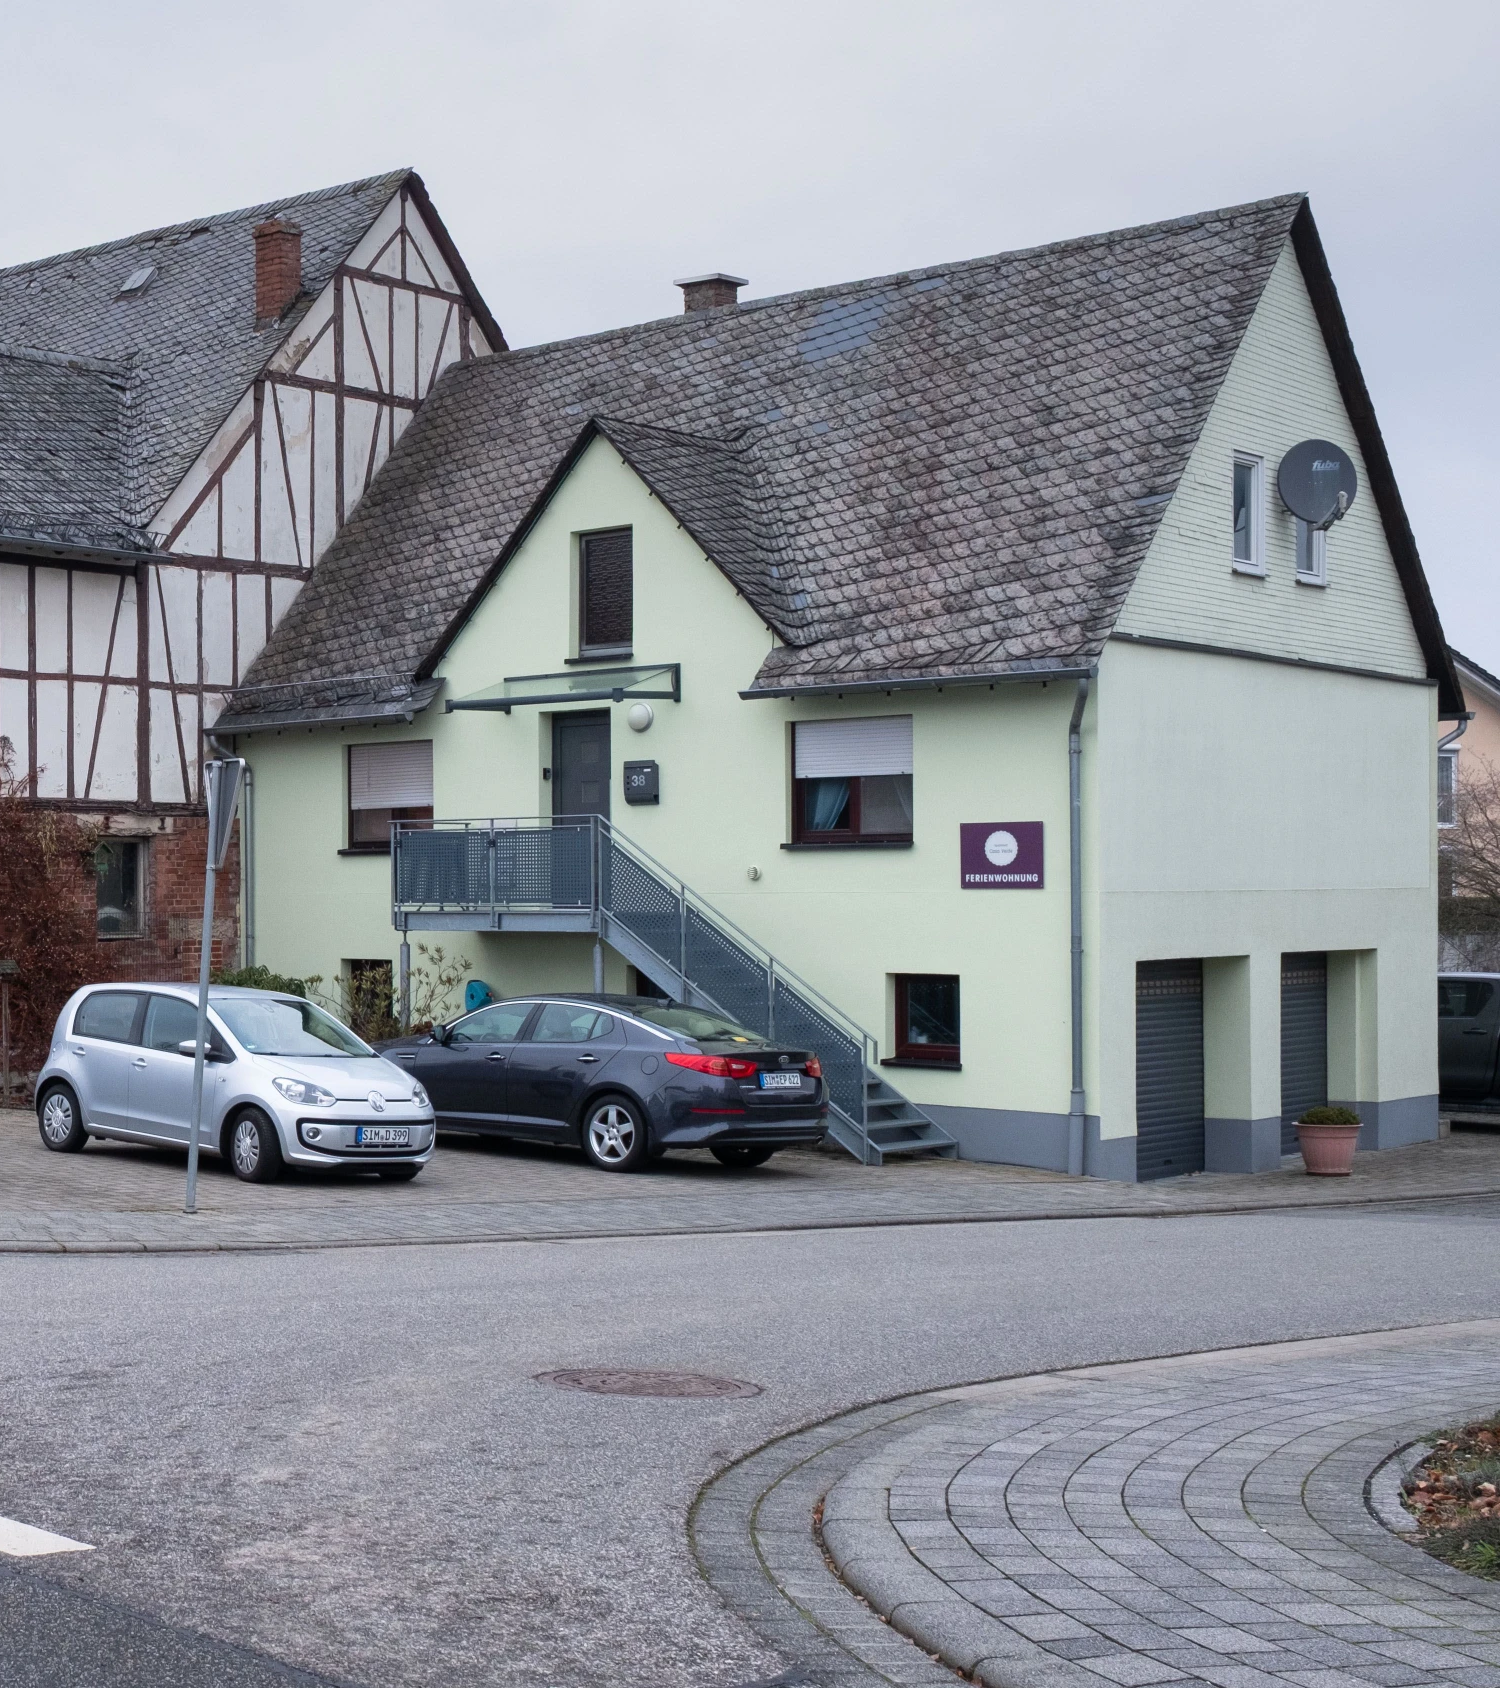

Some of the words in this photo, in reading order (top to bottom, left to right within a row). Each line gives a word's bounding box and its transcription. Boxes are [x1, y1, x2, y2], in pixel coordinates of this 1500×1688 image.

[1312, 460, 1340, 471] fuba
[631, 775, 646, 786] 38
[965, 873, 1039, 883] FERIENWOHNUNG
[764, 1075, 776, 1085] SIM
[362, 1129, 380, 1141] SIM
[384, 1129, 391, 1141] D
[391, 1129, 408, 1141] 399
